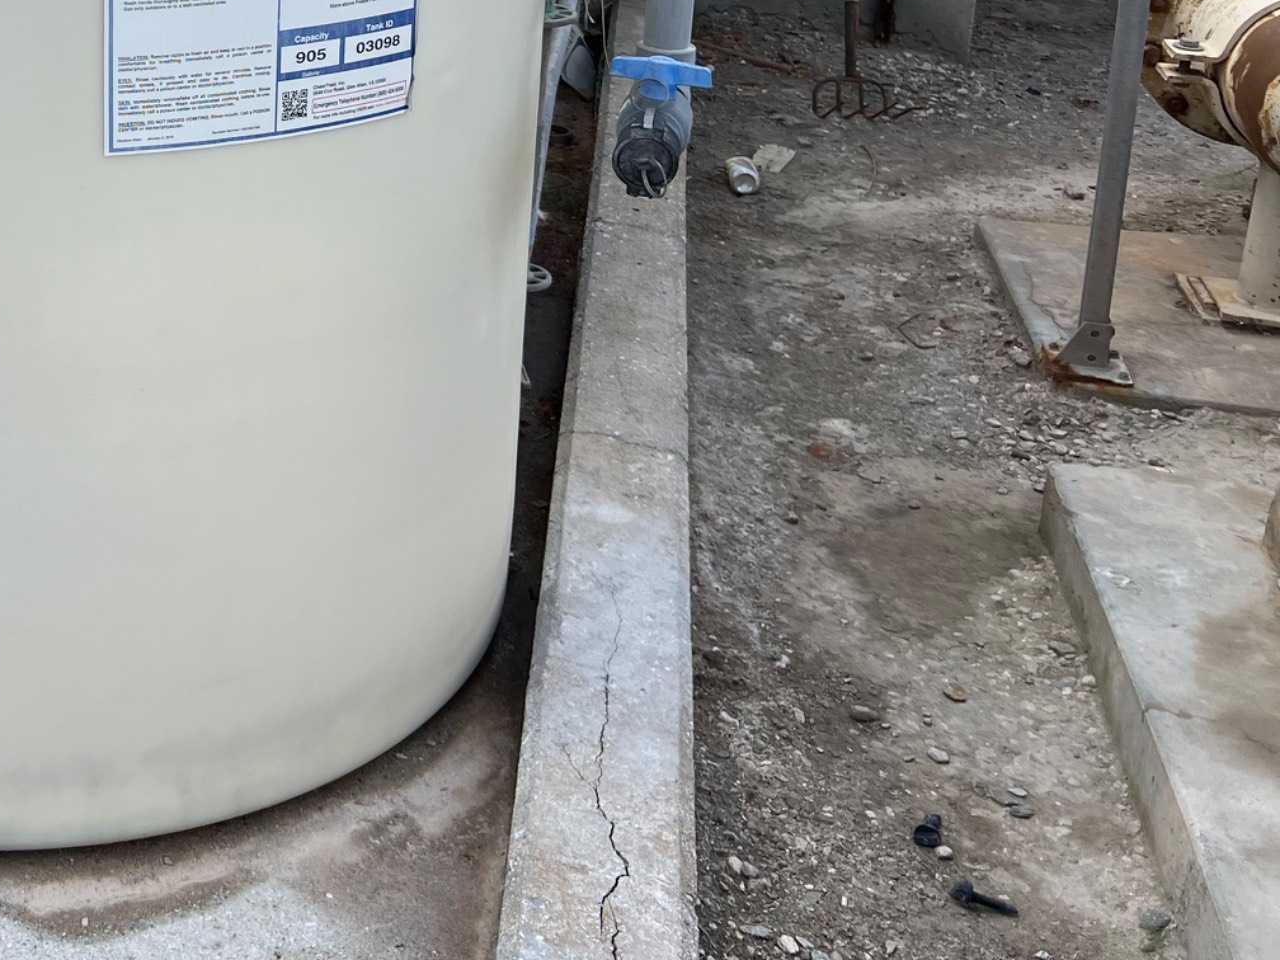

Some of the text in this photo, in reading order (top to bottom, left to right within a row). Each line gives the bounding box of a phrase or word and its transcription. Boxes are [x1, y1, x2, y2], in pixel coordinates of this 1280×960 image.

[366, 19, 394, 32] Tank ID
[294, 31, 329, 44] Capacity
[356, 34, 400, 54] 03098
[296, 48, 327, 64] 905
